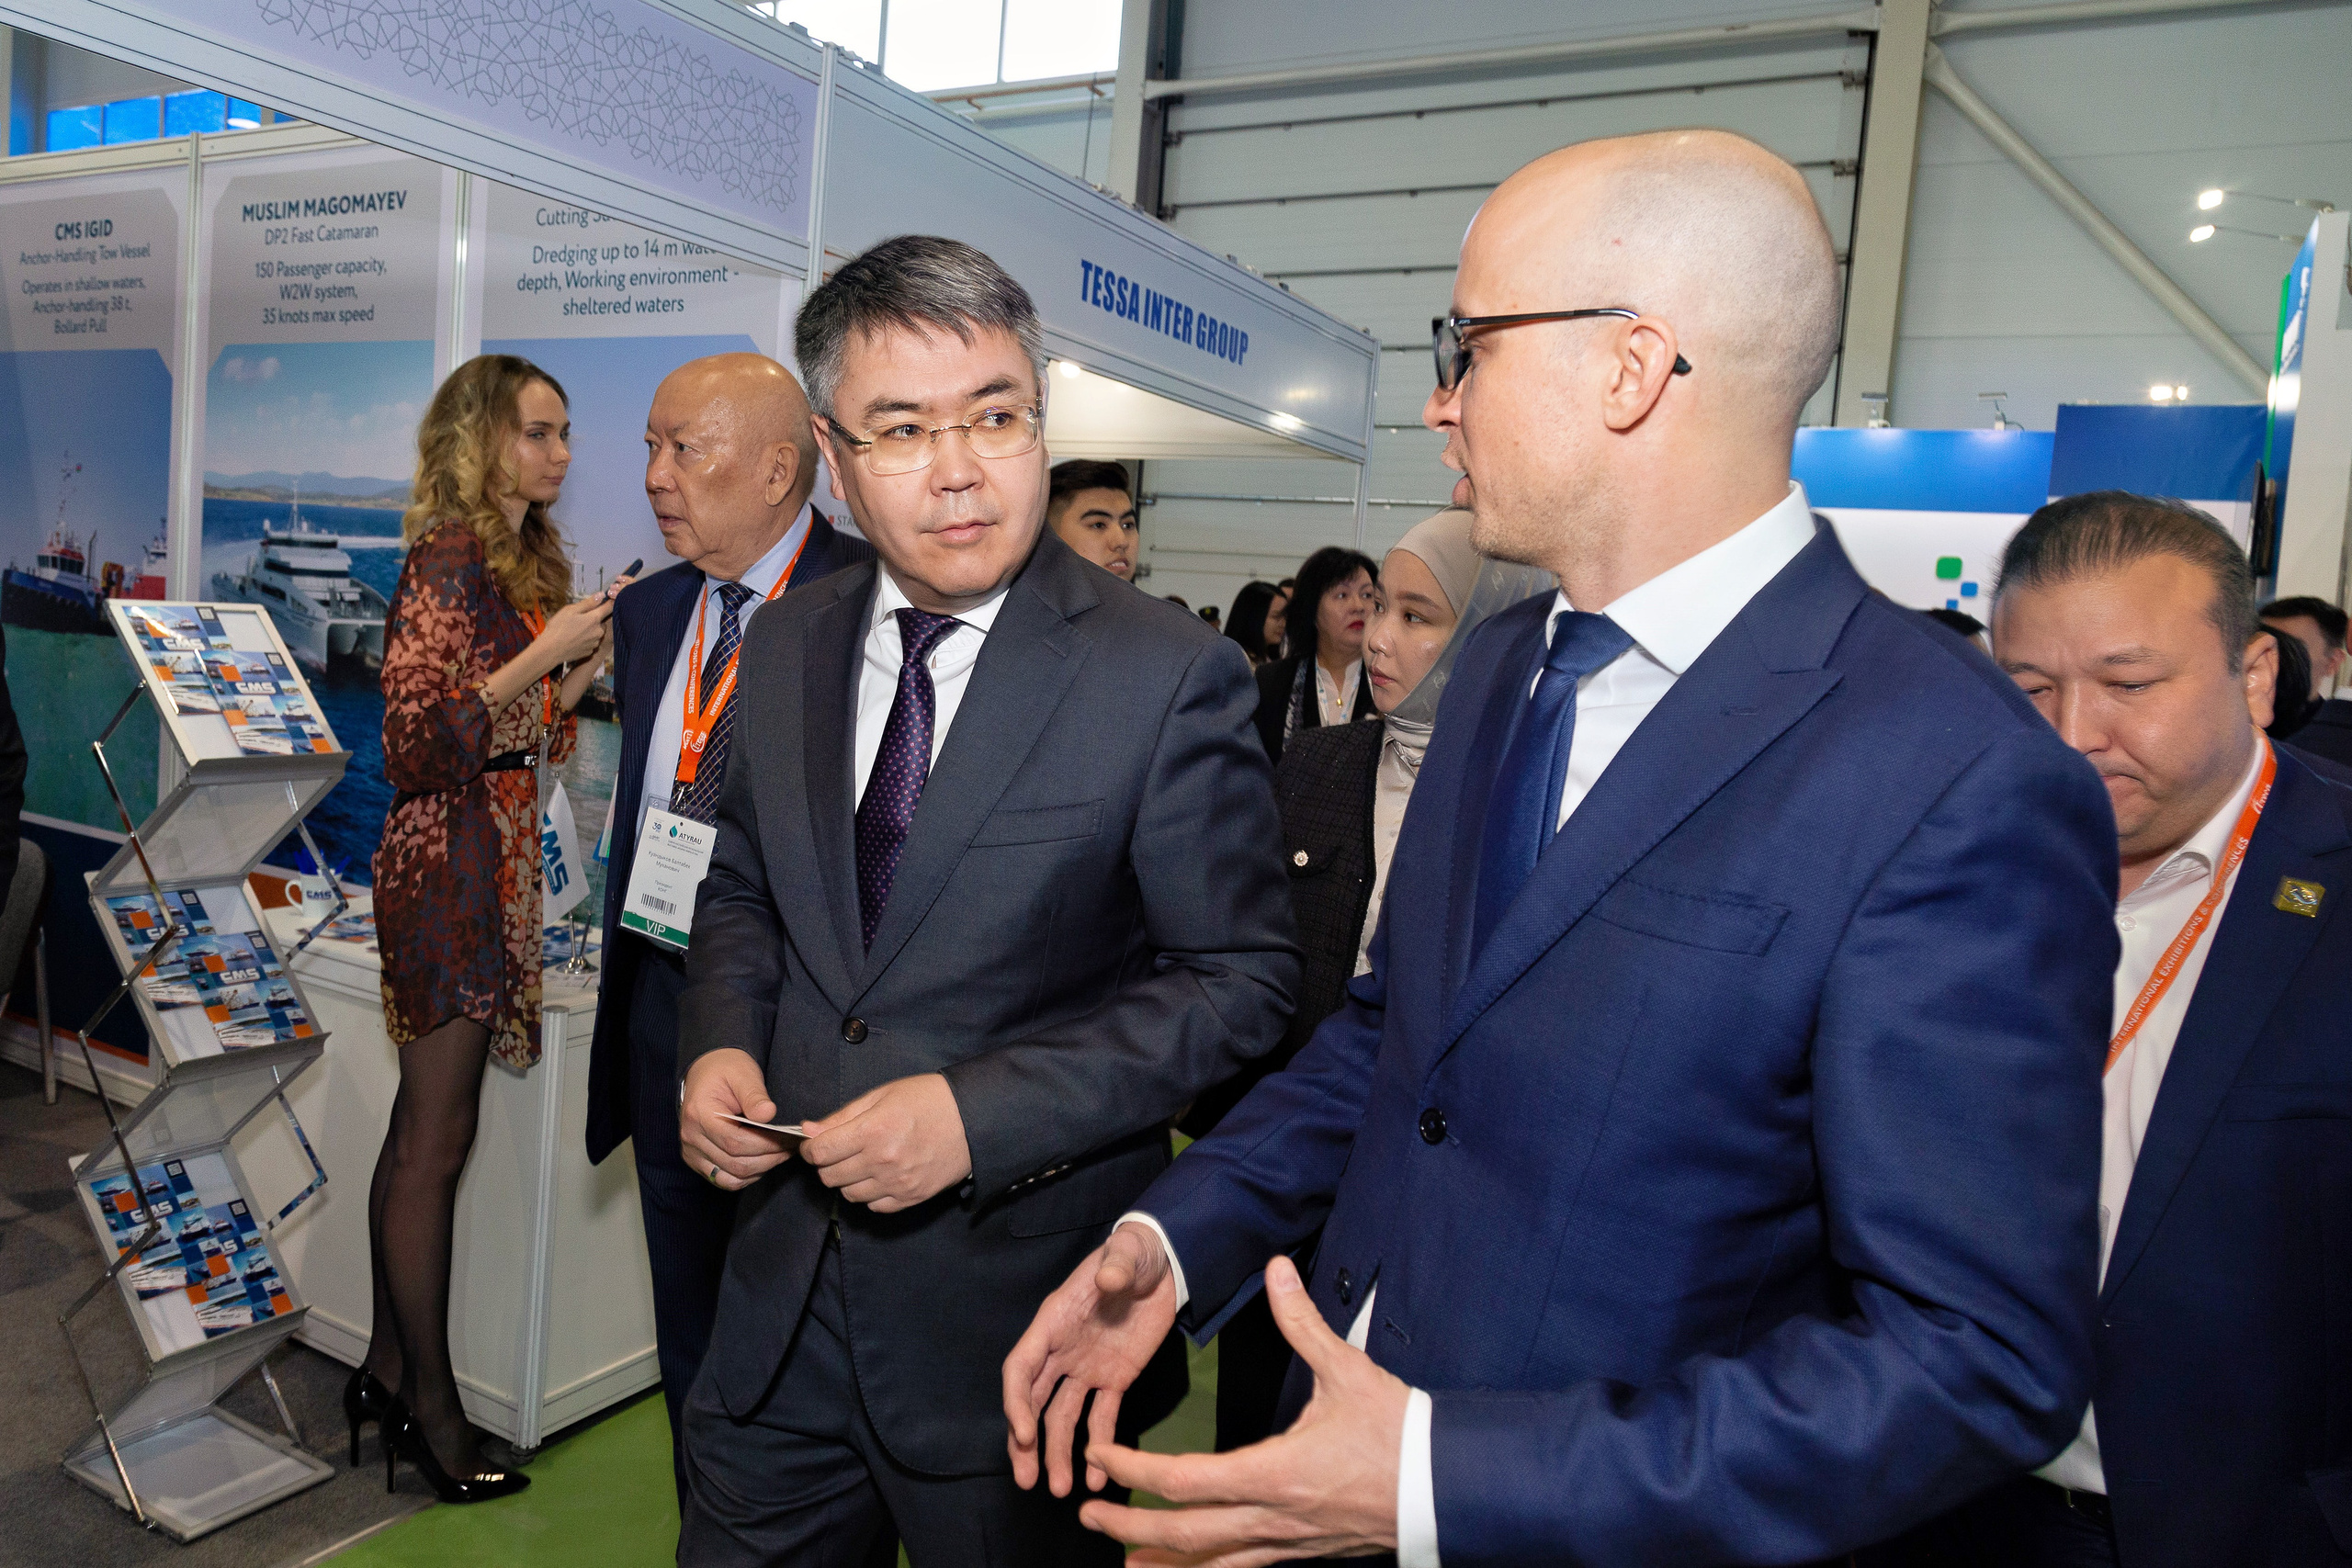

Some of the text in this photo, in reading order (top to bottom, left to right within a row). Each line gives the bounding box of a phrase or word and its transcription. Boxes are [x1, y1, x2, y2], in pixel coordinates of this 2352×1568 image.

[242, 189, 408, 222] MUSLIM MAGOMAYEV
[536, 208, 589, 229] Cutting
[54, 219, 114, 241] CMS IGID
[265, 224, 379, 245] DP2 Fast Catamaran
[119, 241, 152, 259] Vessel
[533, 243, 597, 267] Dredging
[602, 247, 621, 264] up
[624, 243, 639, 259] to
[644, 238, 660, 258] 14
[664, 243, 678, 256] m
[255, 257, 388, 280] 150 Passenger capacity,
[516, 272, 562, 295] depth,
[564, 269, 626, 292] Working
[629, 265, 729, 287] environment
[279, 283, 358, 303] W2W system,
[262, 304, 375, 325] 35 knots max speed
[562, 295, 685, 316] sheltered waters
[1080, 258, 1250, 367] TESSA INTER GROUP
[162, 637, 207, 651] CMS
[235, 682, 277, 694] CMS
[687, 670, 697, 715] CONFERENCES
[709, 665, 737, 716] INTERNATIONAL
[678, 831, 703, 845] ATYRAU
[306, 889, 333, 900] CMS
[646, 919, 666, 936] VIP
[220, 967, 261, 985] CMS
[2111, 977, 2165, 1053] INTERNATIONAL
[2159, 915, 2204, 977] EXHIBITIONS
